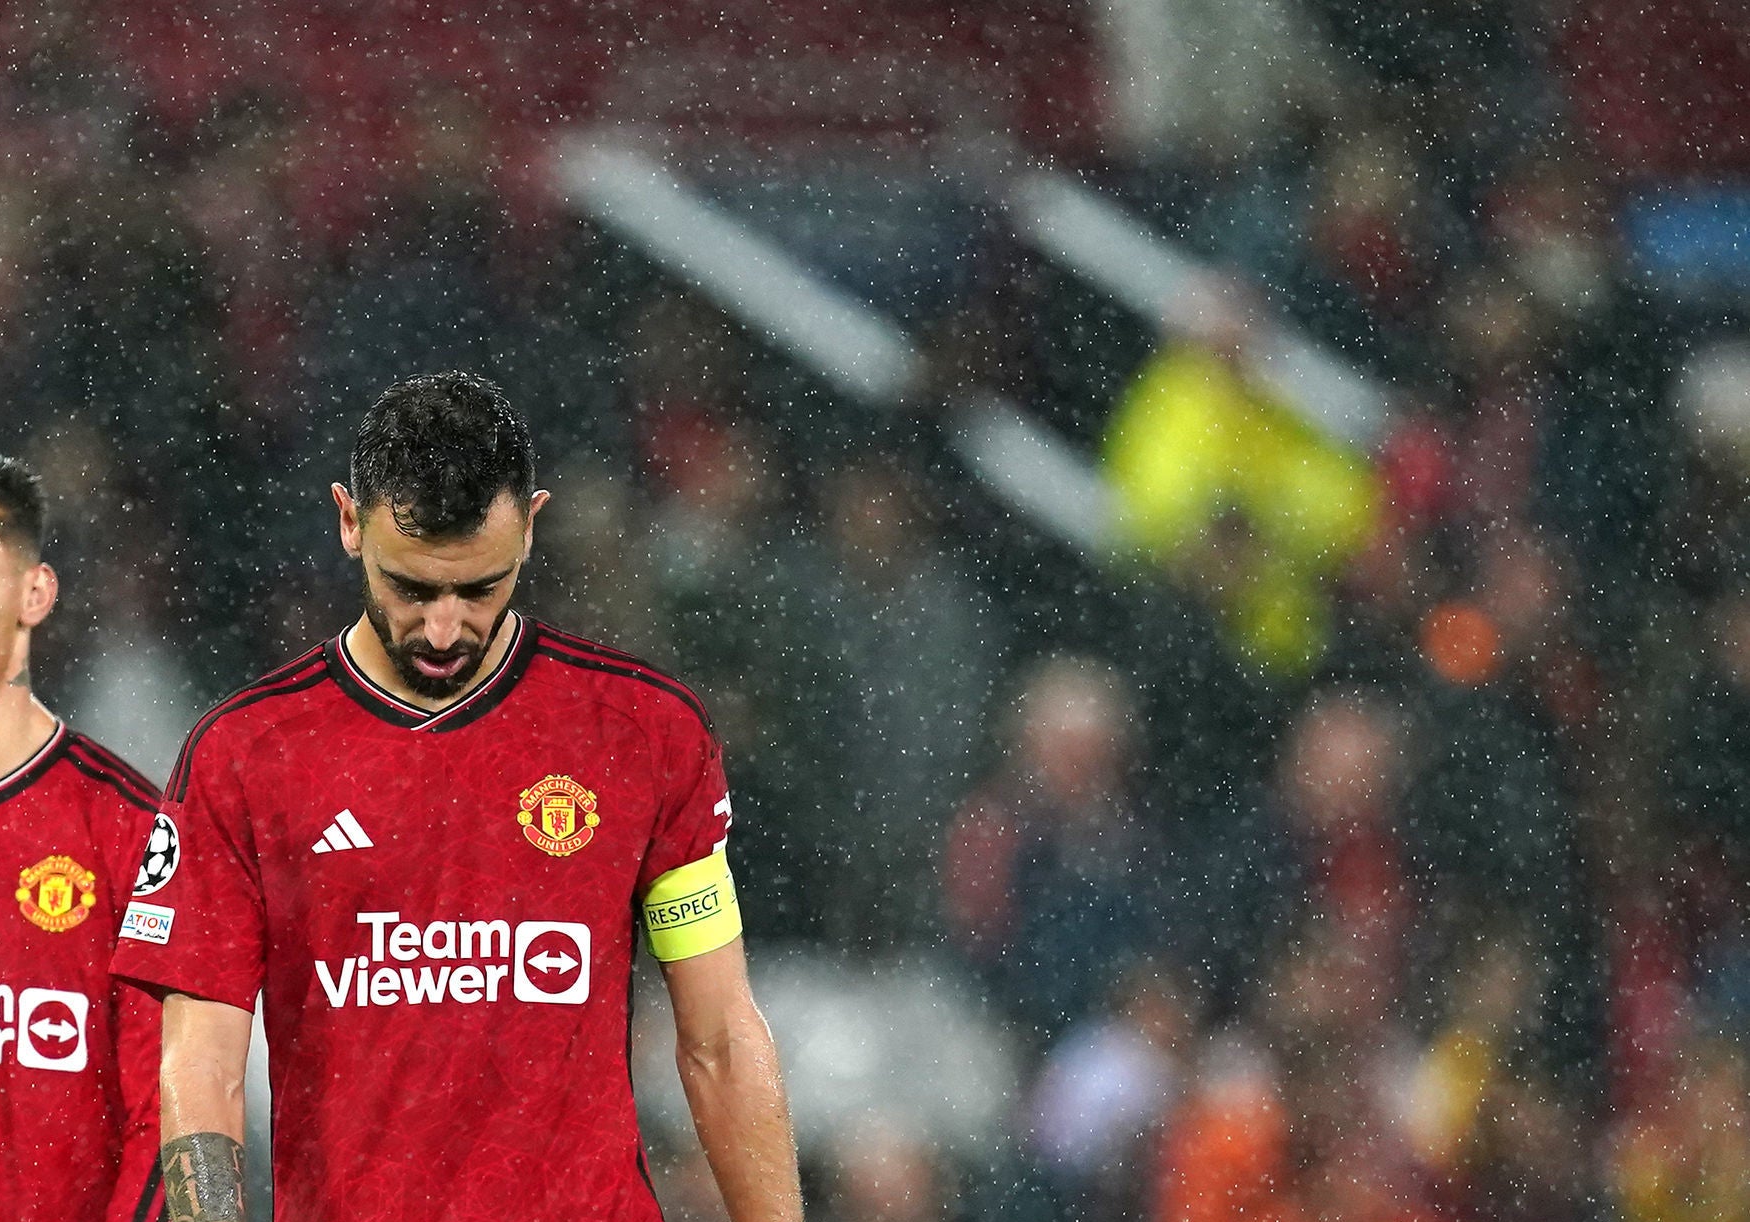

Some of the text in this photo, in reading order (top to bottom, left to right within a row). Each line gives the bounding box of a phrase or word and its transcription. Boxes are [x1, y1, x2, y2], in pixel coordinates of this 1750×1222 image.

[525, 781, 591, 808] MANCHESTER
[537, 837, 582, 851] UNITED
[648, 890, 719, 926] RESPECT
[356, 911, 510, 962] Team
[314, 956, 509, 1008] Viewer
